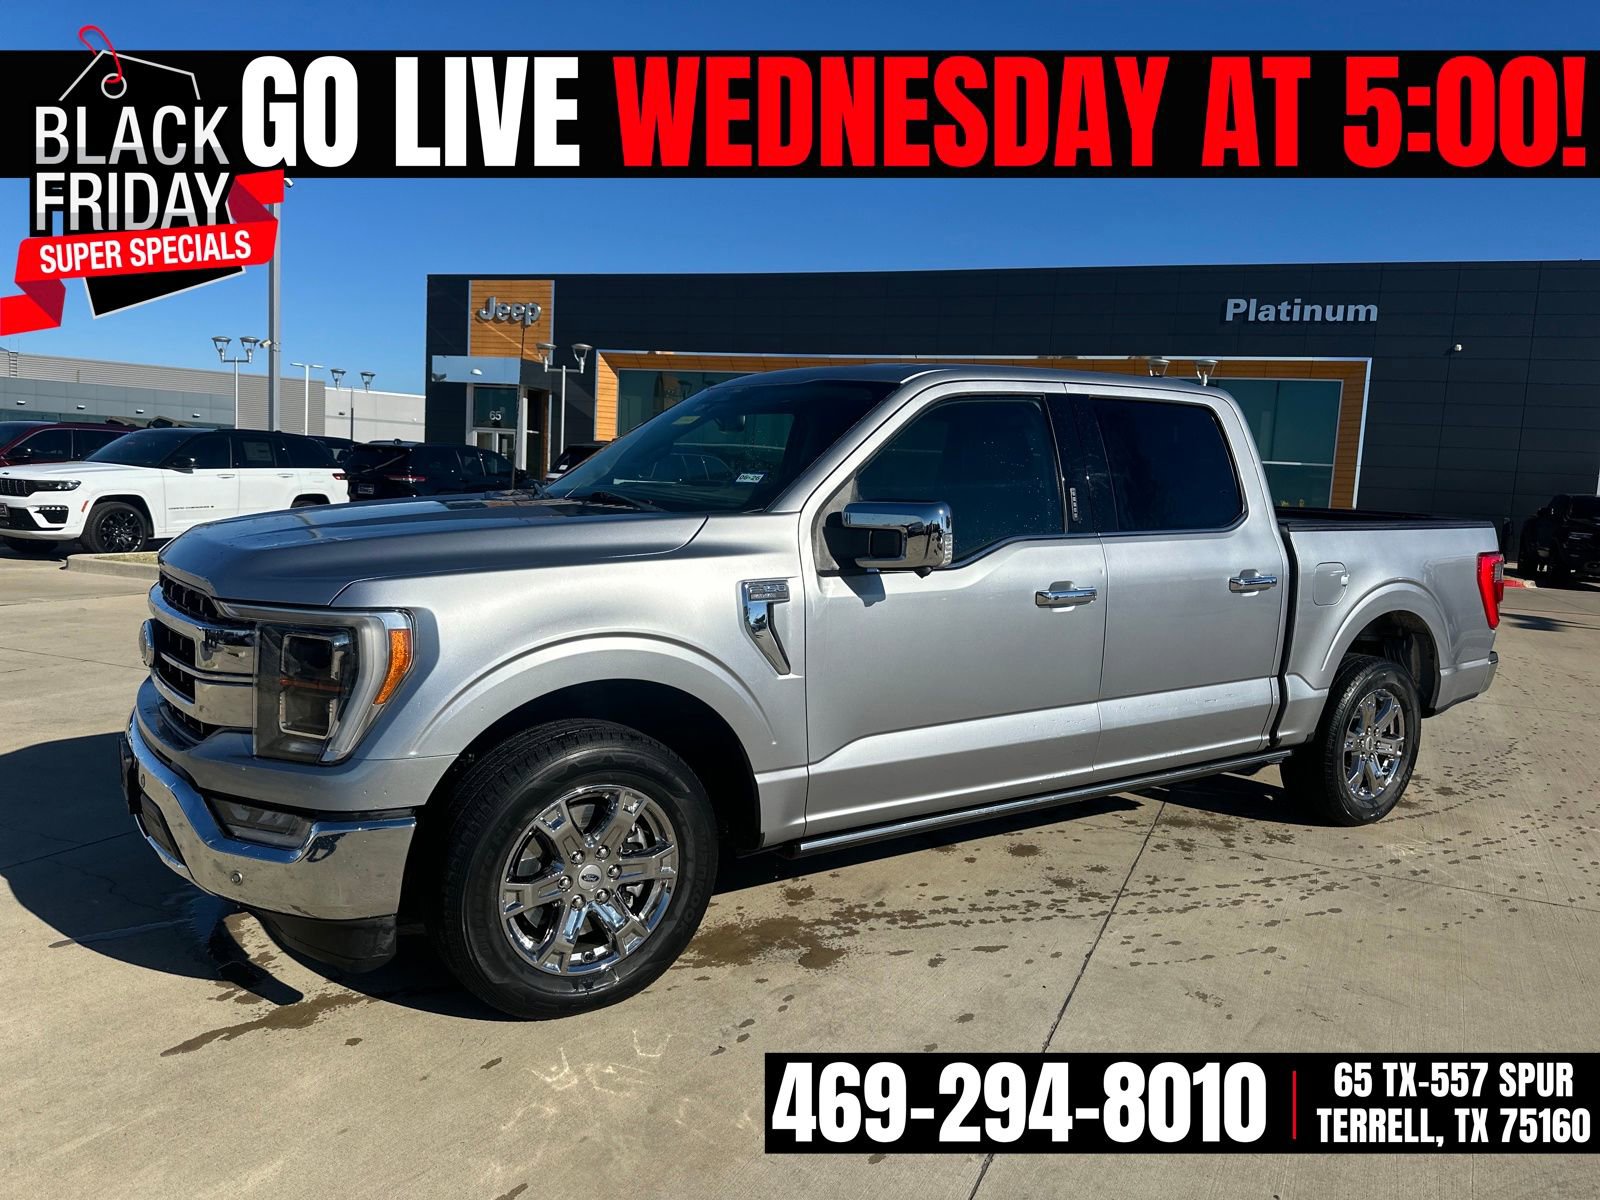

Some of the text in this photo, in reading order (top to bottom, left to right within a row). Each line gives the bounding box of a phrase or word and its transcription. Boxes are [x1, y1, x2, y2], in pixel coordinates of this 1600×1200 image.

[480, 296, 542, 326] Jeep
[1225, 298, 1378, 322] Platinum
[489, 411, 502, 420] 65
